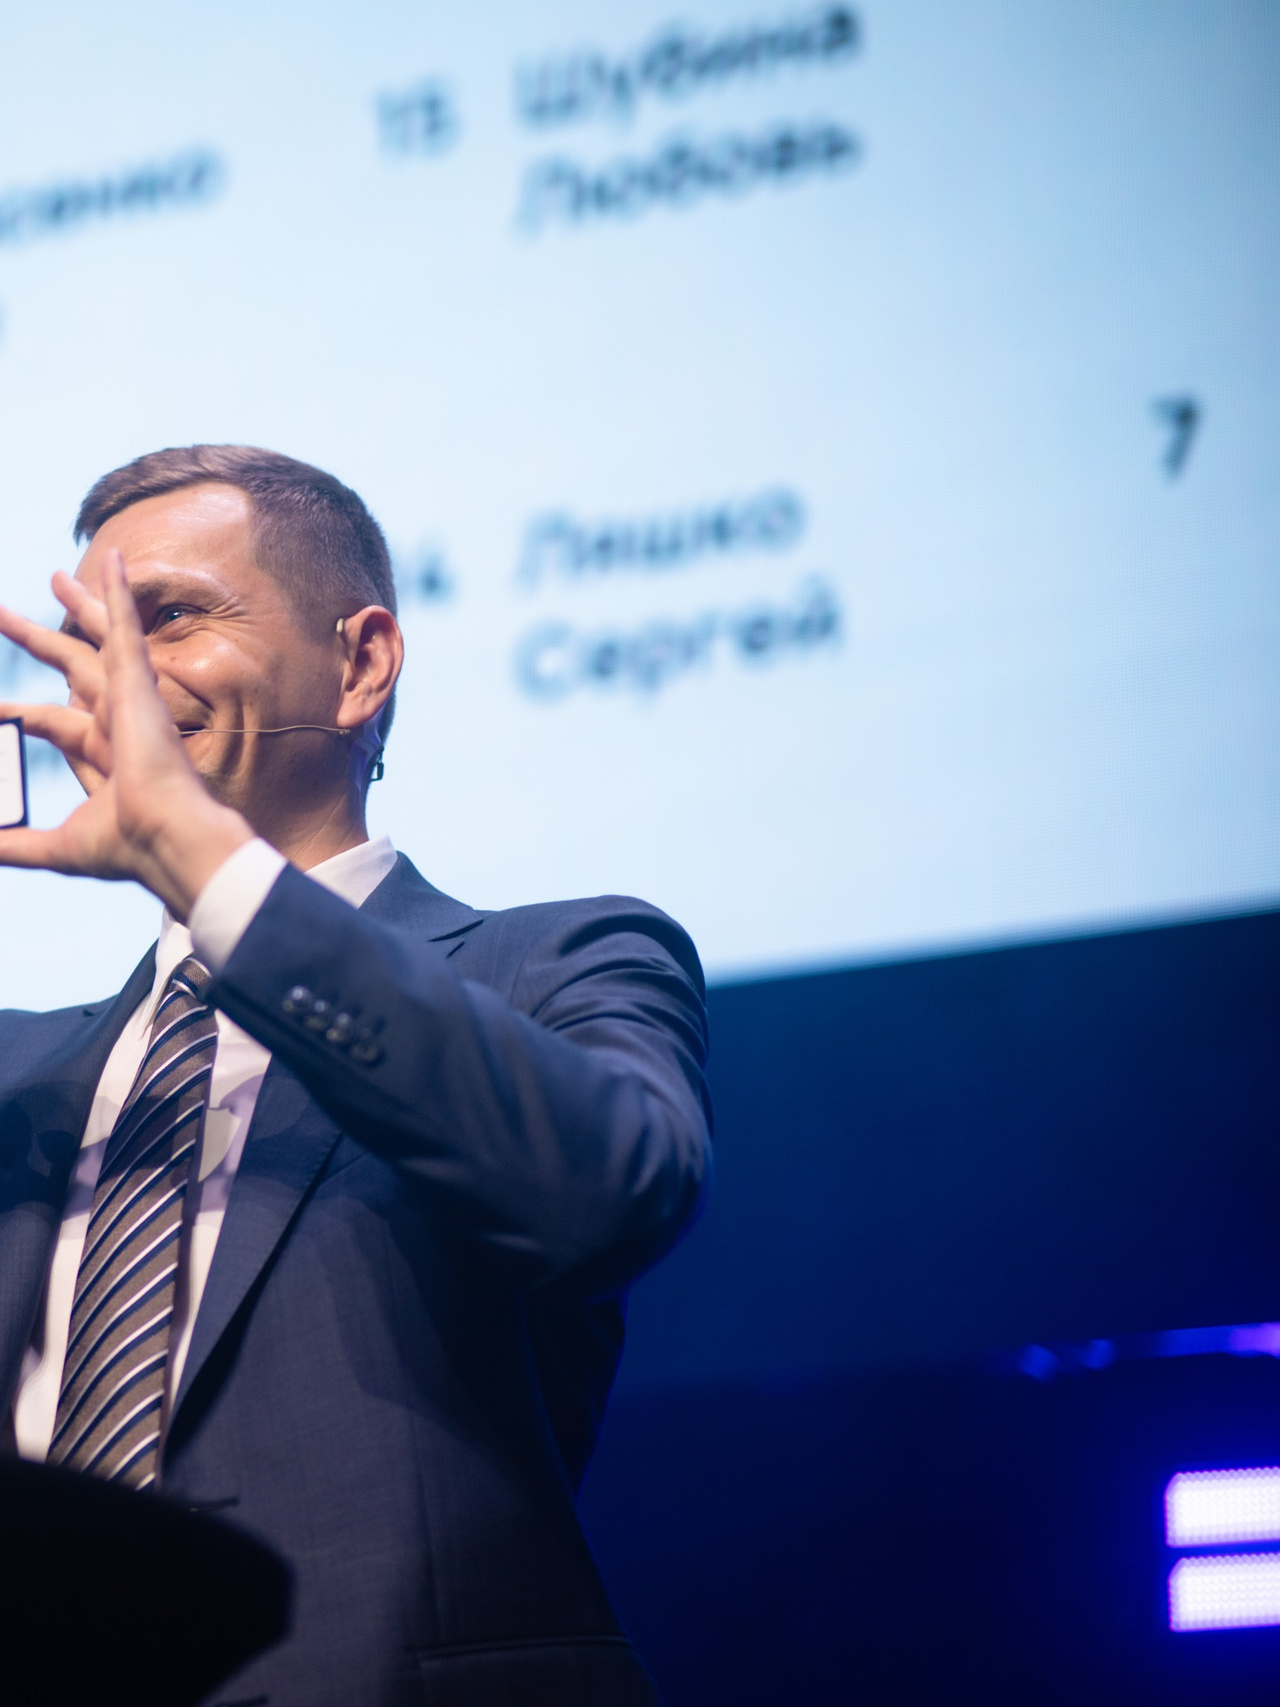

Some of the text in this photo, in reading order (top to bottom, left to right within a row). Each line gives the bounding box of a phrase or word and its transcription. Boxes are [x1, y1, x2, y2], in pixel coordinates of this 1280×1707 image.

[519, 4, 867, 124] Шубина
[518, 118, 867, 236] Любовь
[1150, 390, 1206, 482] 7
[516, 576, 846, 702] Сергей
